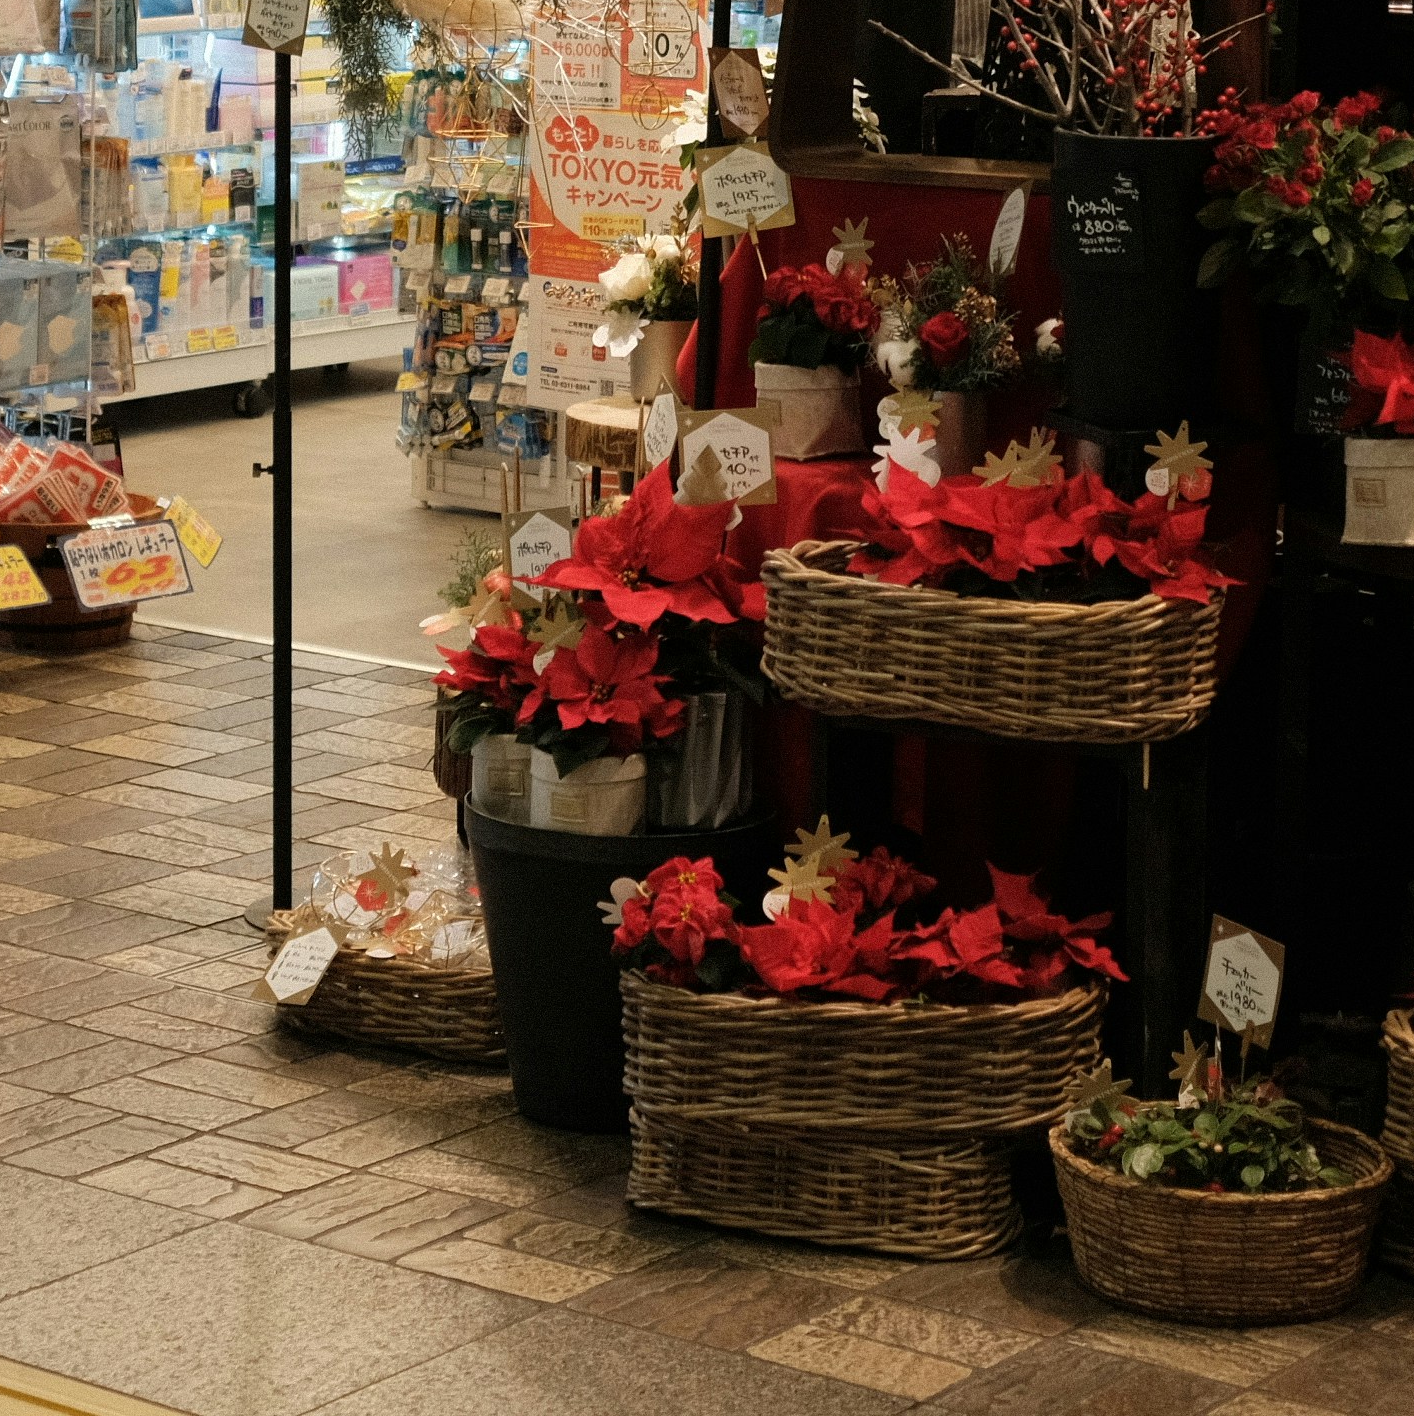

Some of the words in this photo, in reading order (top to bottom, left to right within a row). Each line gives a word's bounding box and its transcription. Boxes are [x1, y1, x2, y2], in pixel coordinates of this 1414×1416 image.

[602, 134, 671, 154] 暮らしを応
[547, 153, 684, 192] TOKYO元気
[566, 185, 663, 213] キャンペーン
[732, 189, 760, 206] 1925
[1084, 219, 1115, 236] 880
[68, 538, 133, 570] 貼らないホカロン
[104, 554, 175, 586] 63
[1229, 989, 1257, 1011] 1980
